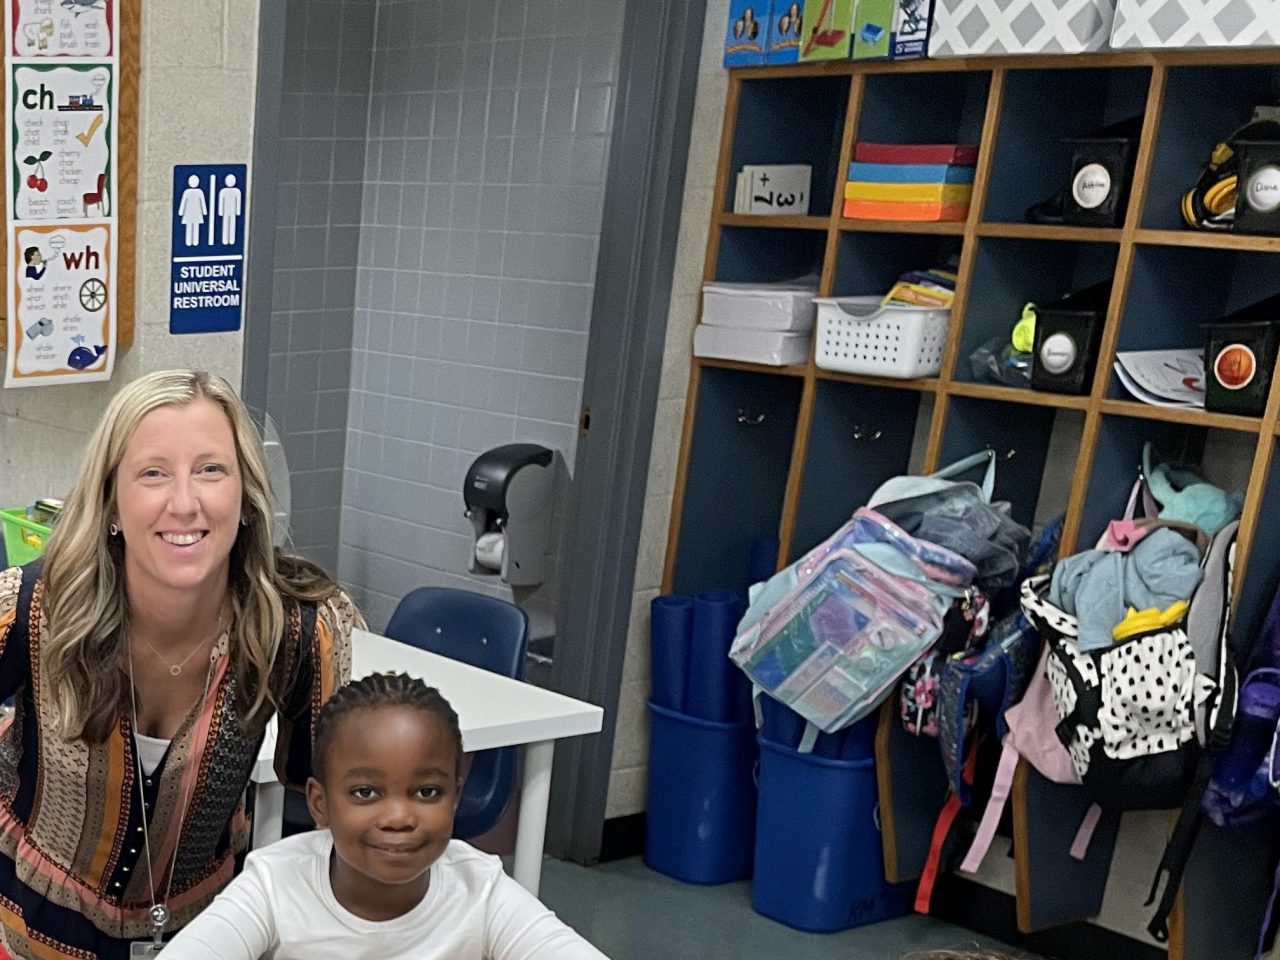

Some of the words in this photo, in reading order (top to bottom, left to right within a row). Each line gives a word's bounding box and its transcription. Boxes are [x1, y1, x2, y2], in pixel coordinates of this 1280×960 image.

[22, 84, 54, 110] ch
[776, 193, 796, 207] 3
[62, 244, 100, 270] wh
[180, 264, 236, 278] STUDENT
[174, 280, 240, 294] UNIVERSAL
[173, 294, 240, 309] RESTROOM
